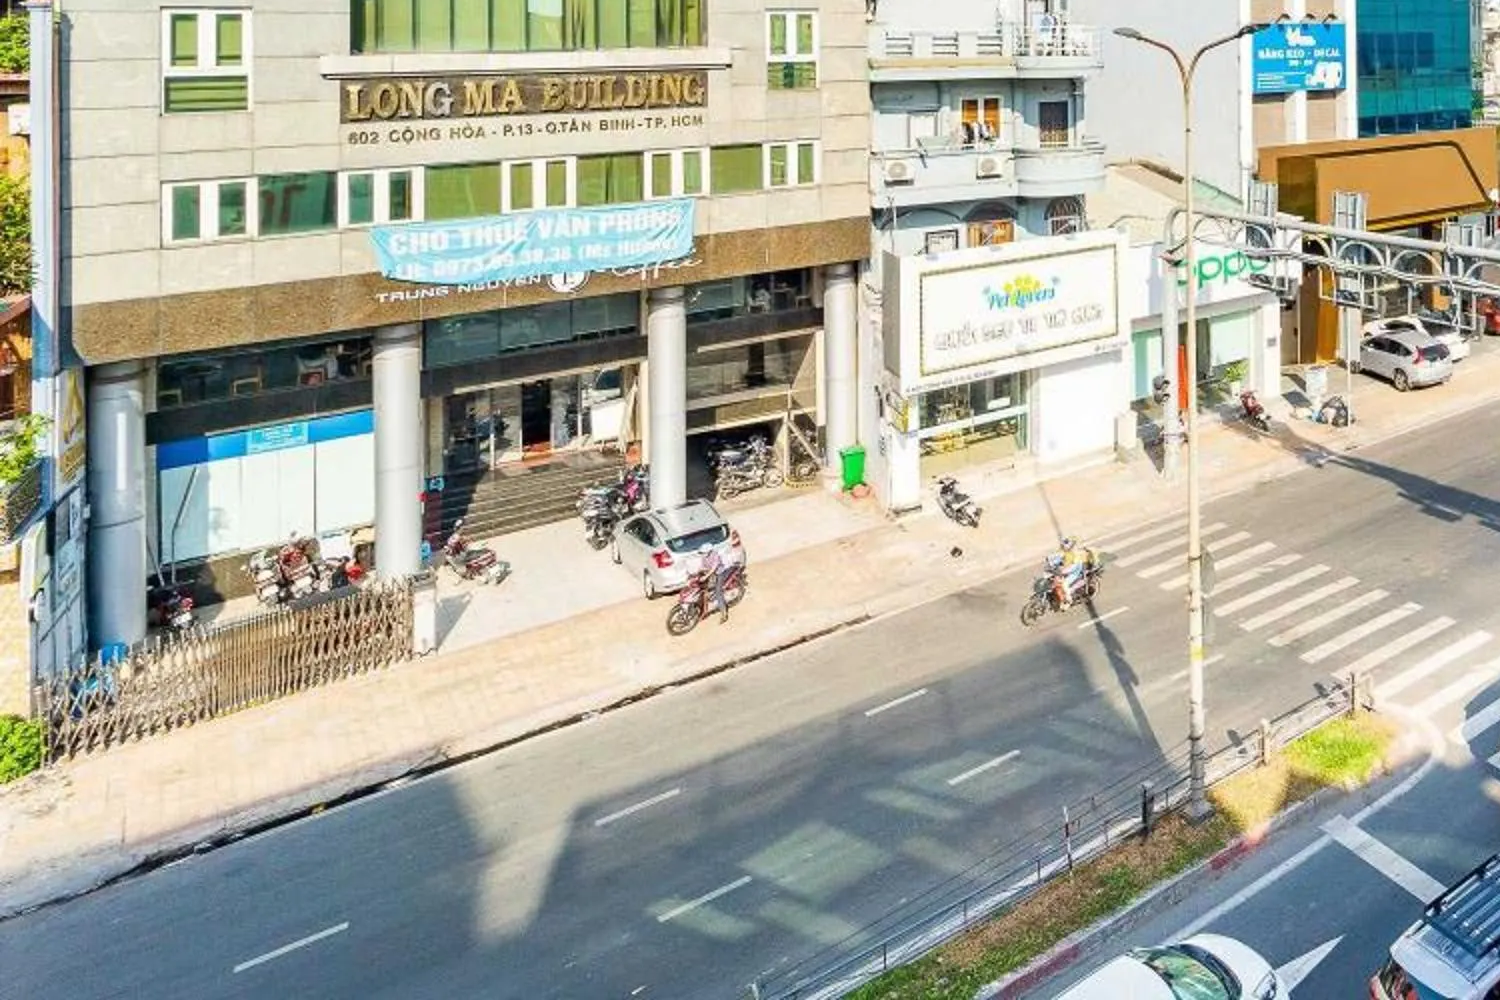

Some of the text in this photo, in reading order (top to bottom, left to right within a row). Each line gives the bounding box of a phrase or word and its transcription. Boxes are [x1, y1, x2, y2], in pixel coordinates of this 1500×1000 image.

[346, 72, 705, 122] LONG MA BUILDING
[348, 131, 380, 145] 602
[375, 285, 449, 304] TRUNG
